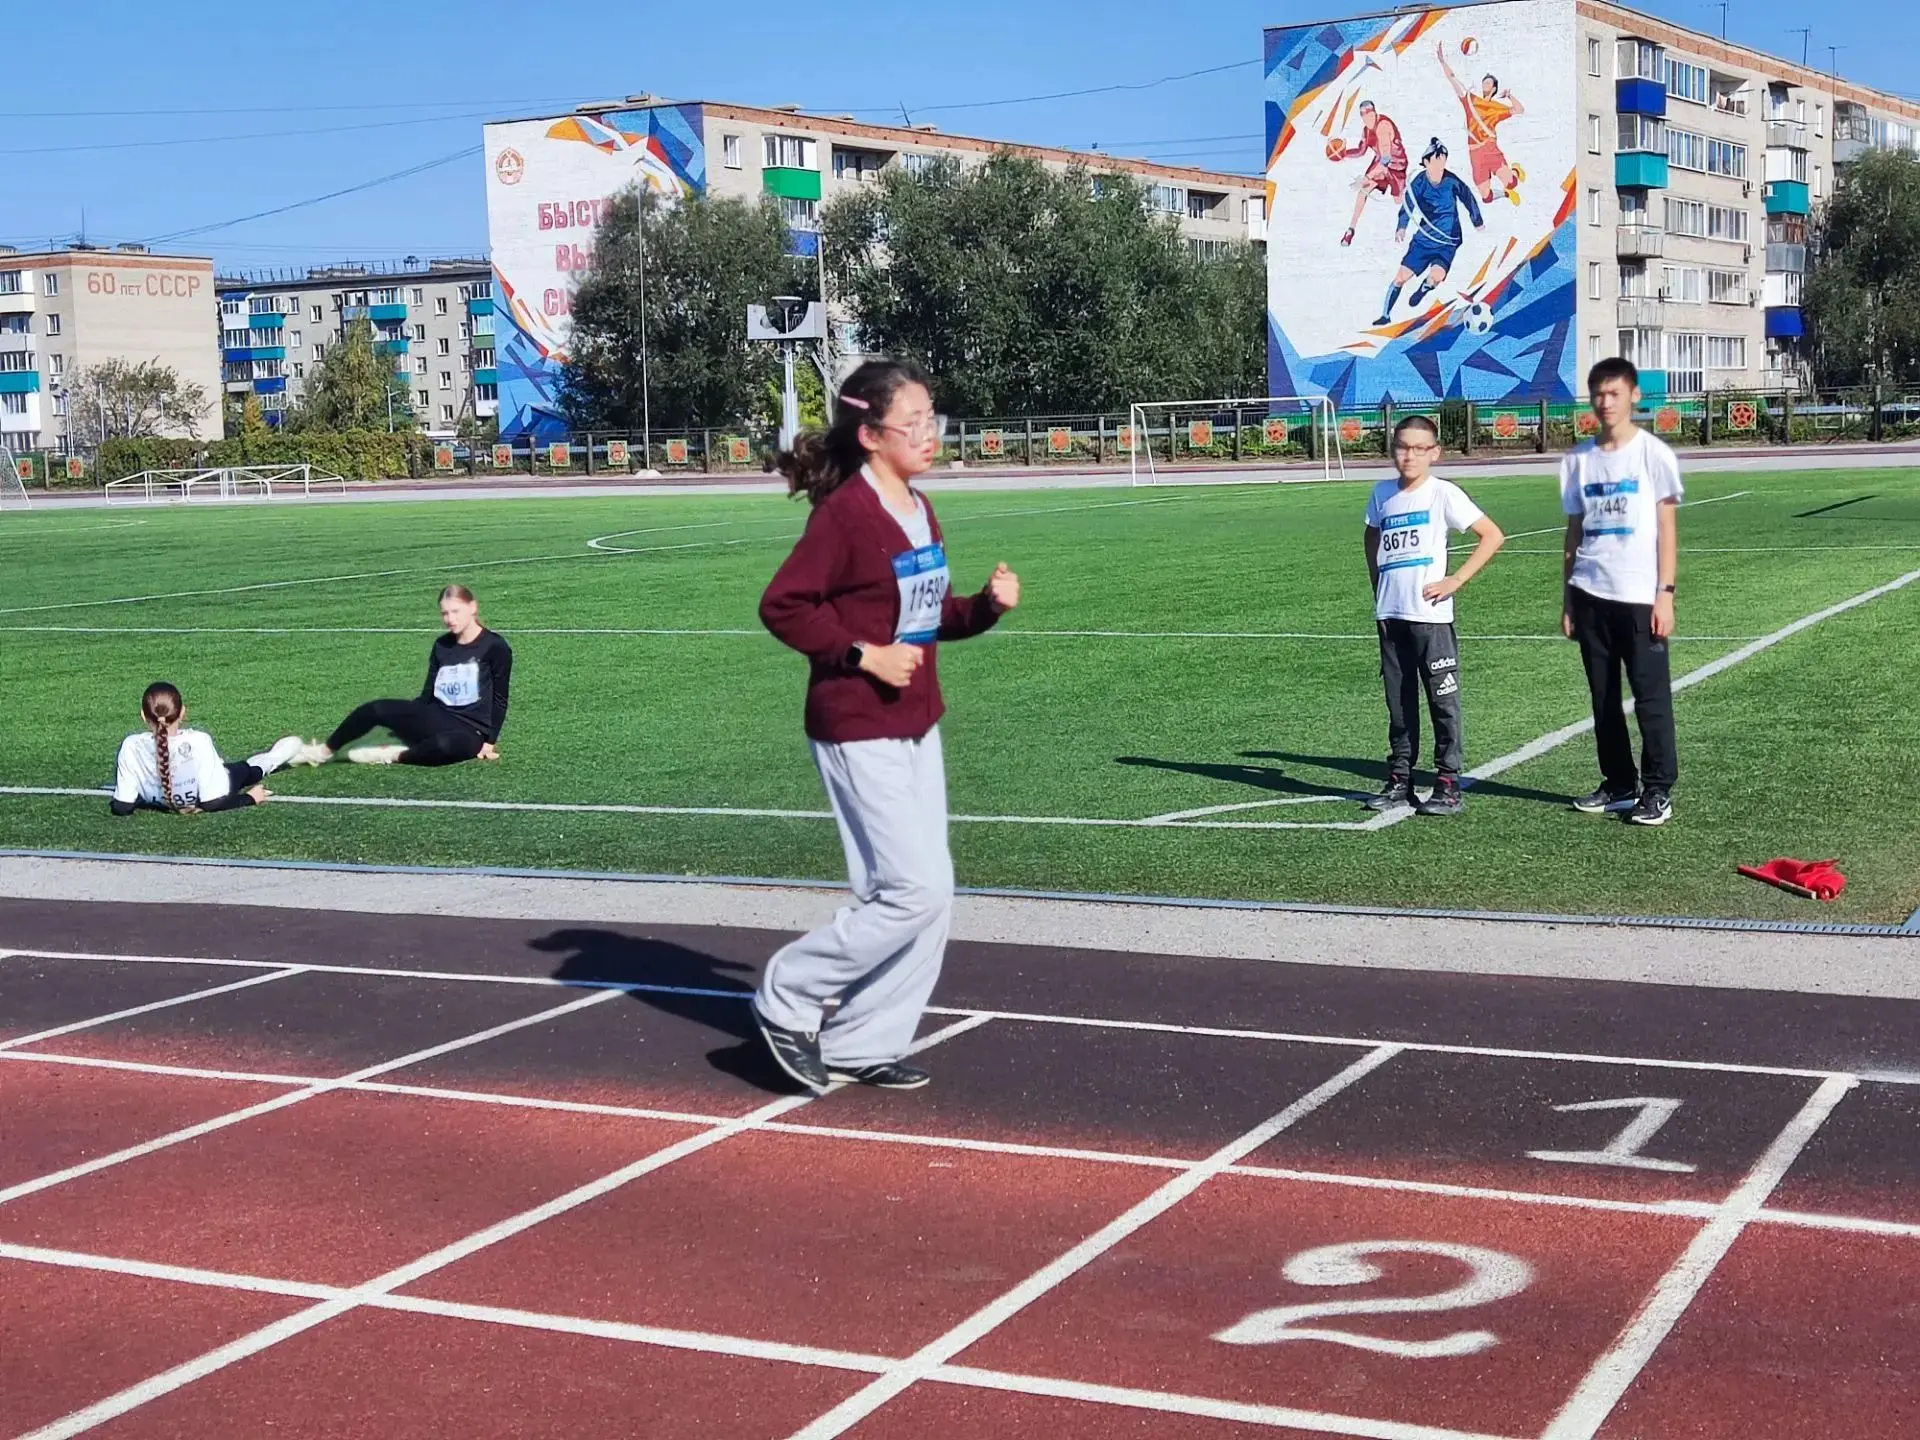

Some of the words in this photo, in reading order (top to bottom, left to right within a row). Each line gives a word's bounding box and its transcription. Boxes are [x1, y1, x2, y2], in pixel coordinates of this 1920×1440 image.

[88, 272, 115, 294] 60
[146, 273, 200, 297] СССР
[1383, 529, 1419, 551] 8675
[1526, 1097, 1698, 1172] 1
[1210, 1240, 1533, 1358] 2
